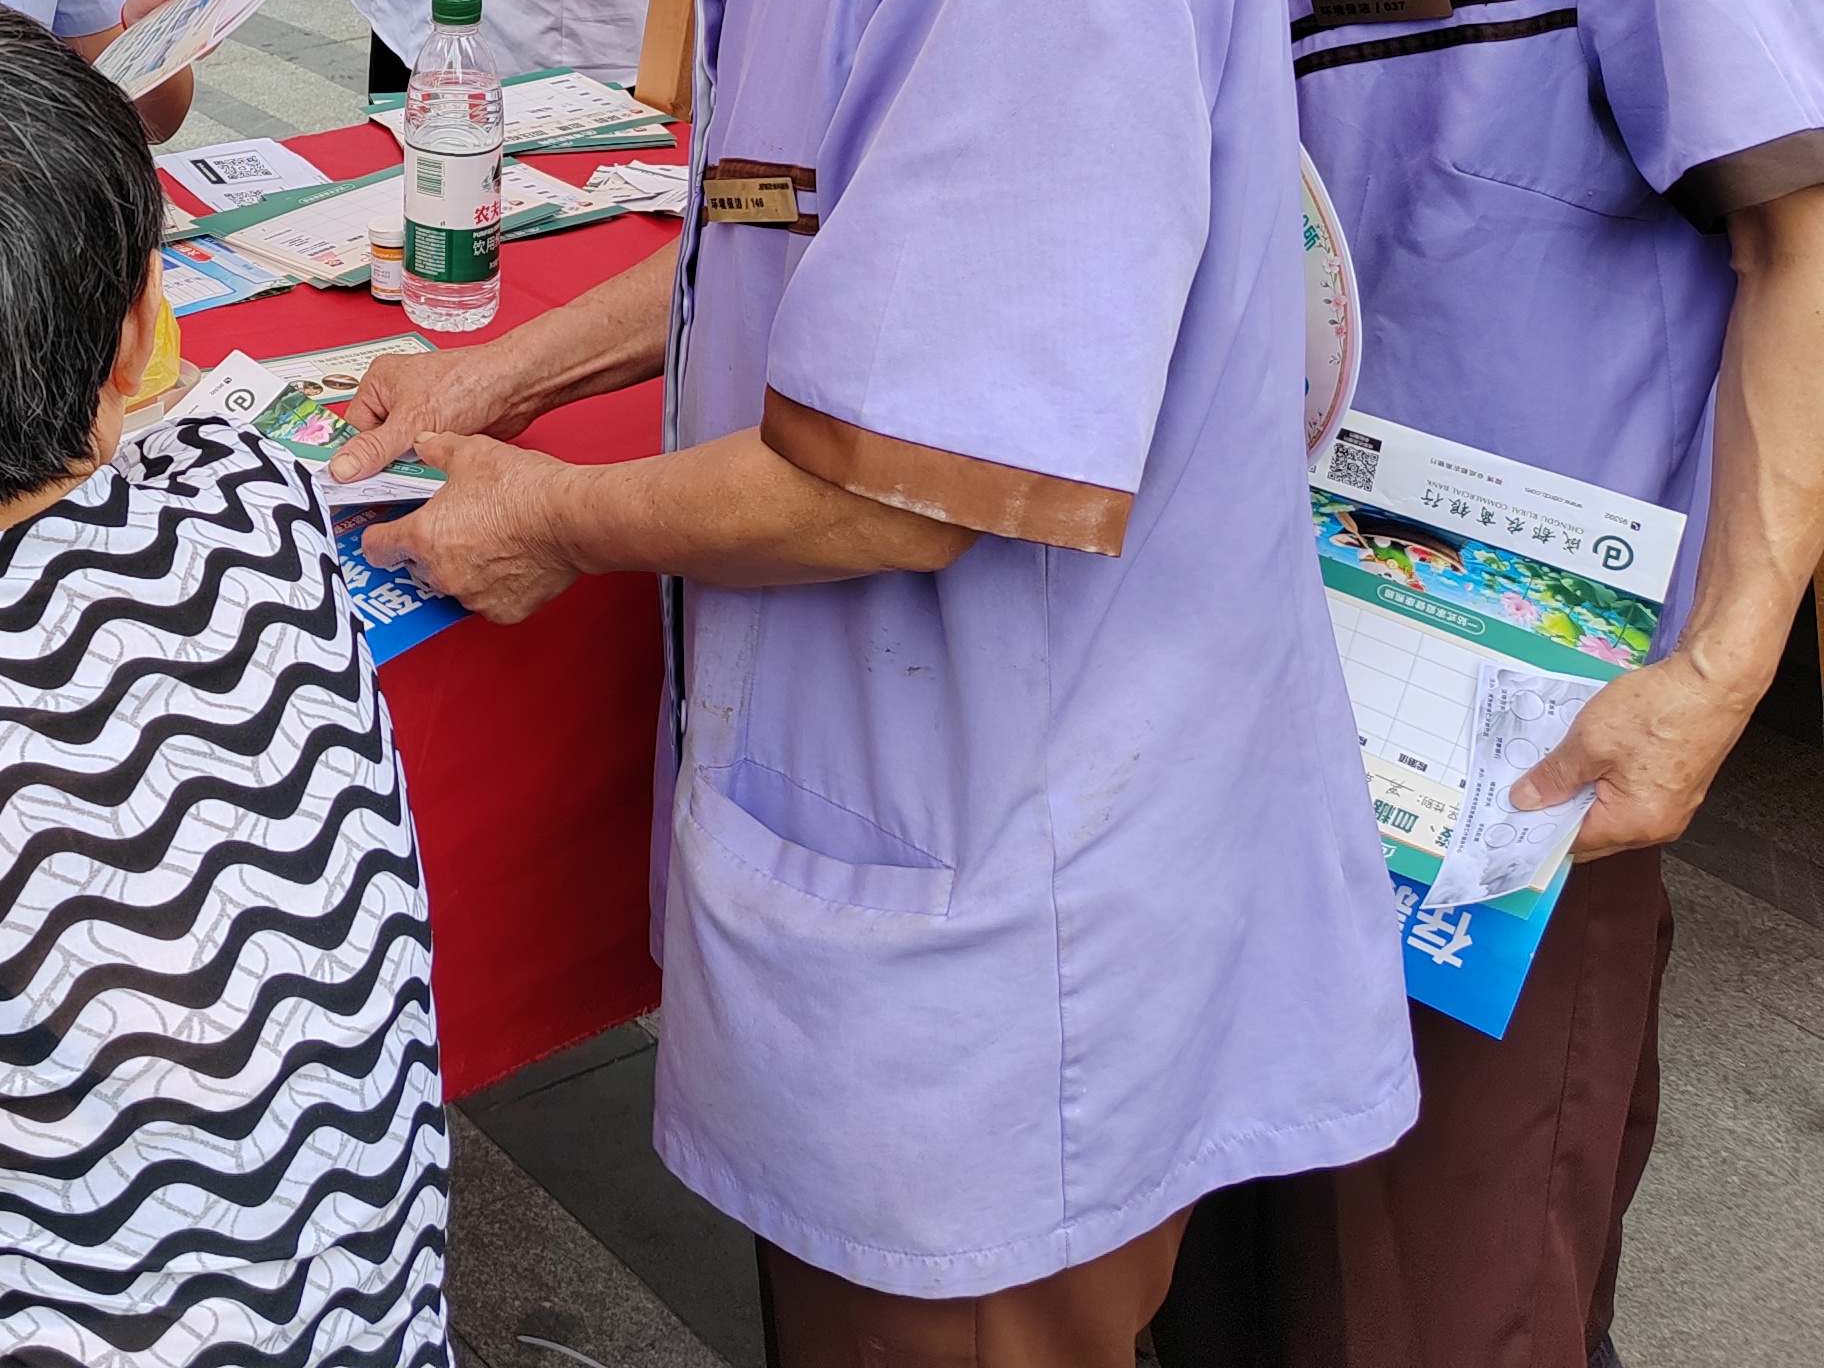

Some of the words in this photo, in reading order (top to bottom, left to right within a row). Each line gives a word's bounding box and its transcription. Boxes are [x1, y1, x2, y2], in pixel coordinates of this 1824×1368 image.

[1383, 0, 1406, 13] 037
[1426, 479, 1450, 494] BANK
[1452, 487, 1509, 512] COMMERCIAL
[1421, 488, 1582, 553] 成都农商银行
[1510, 505, 1539, 521] RURAL
[1541, 515, 1585, 535] CHENGDU
